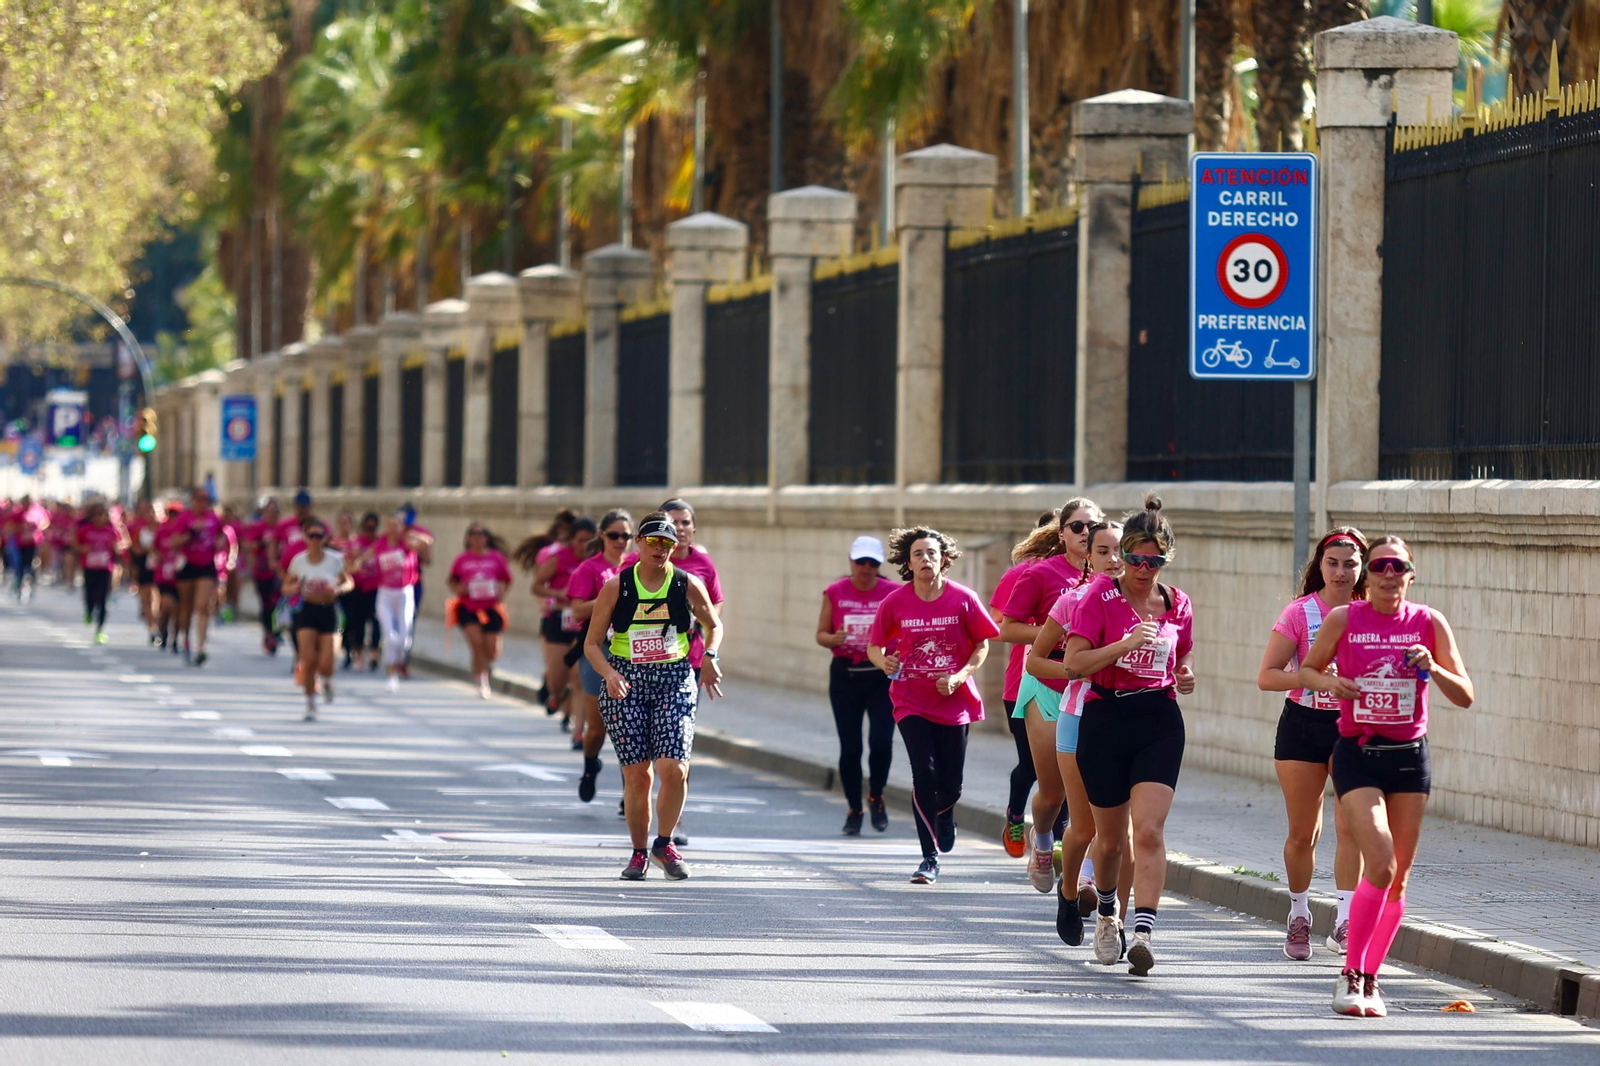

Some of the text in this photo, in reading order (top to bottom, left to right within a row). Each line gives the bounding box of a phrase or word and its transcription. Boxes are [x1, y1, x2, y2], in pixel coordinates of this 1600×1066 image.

[1200, 166, 1308, 185] ATENCIÓN
[1219, 191, 1288, 206] CARRIL
[1208, 212, 1299, 227] DERECHO
[1233, 259, 1272, 282] 30
[1198, 315, 1306, 330] PREFERENCIA
[931, 615, 959, 626] MUJERES
[634, 638, 663, 652] 3588
[1348, 632, 1380, 643] CARRERA
[1389, 632, 1421, 643] MUJERES
[1123, 649, 1153, 664] 2371
[1365, 693, 1393, 709] 632
